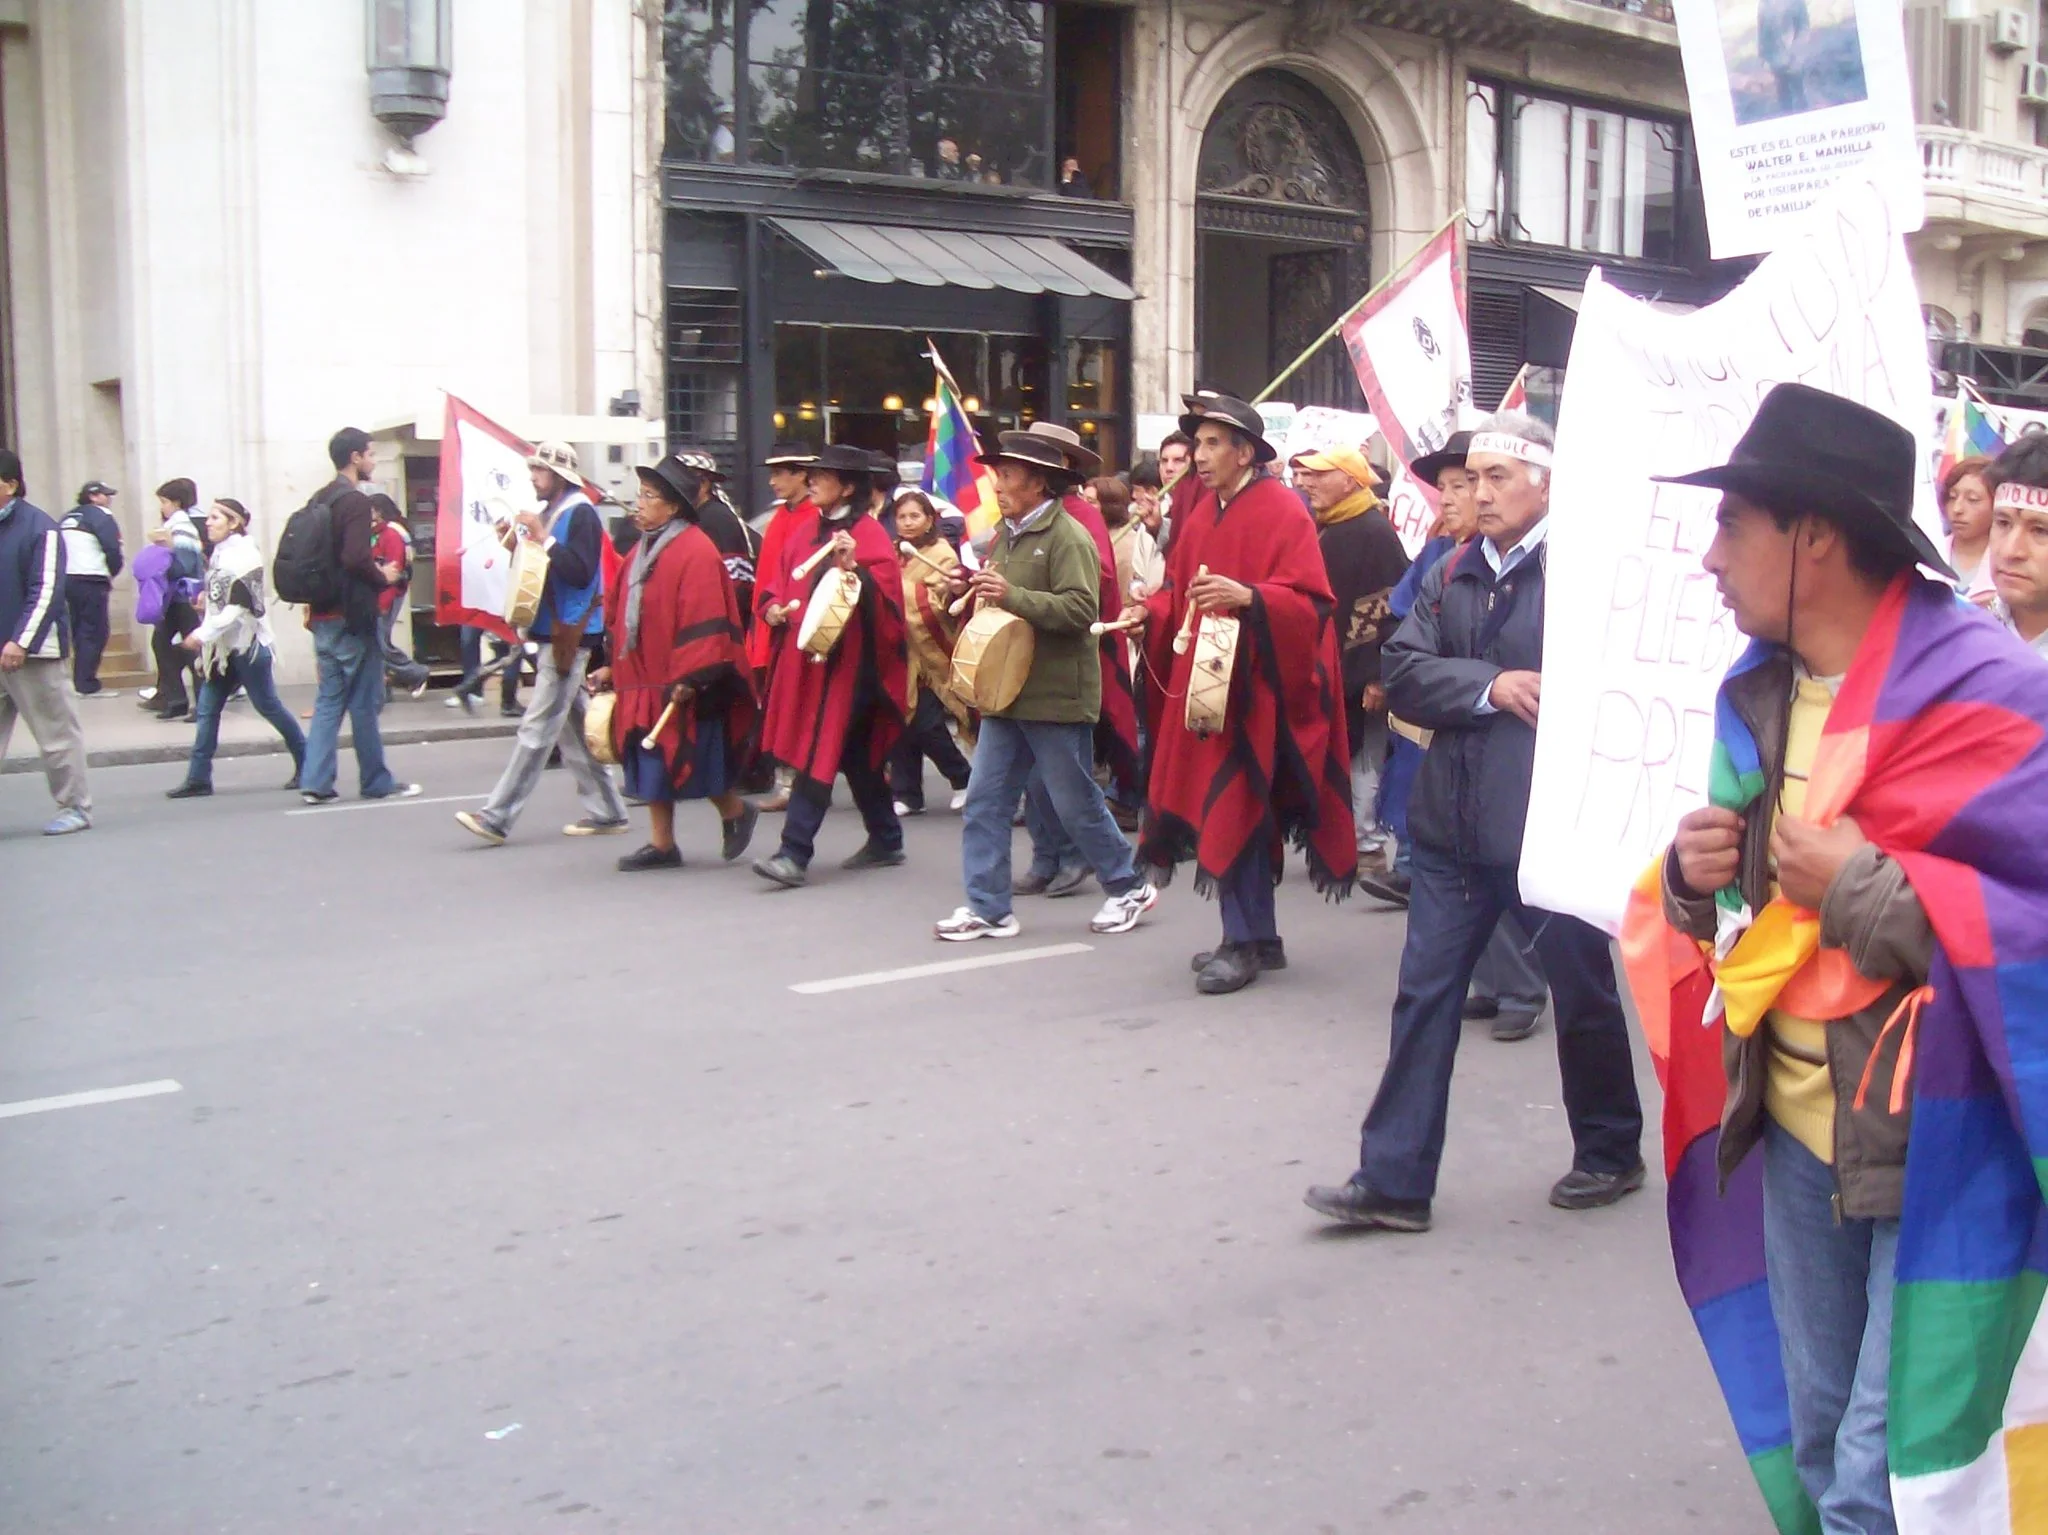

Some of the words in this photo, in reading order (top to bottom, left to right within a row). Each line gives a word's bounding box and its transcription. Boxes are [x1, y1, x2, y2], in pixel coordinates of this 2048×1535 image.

[1730, 144, 1757, 159] ESTE
[1761, 140, 1776, 152] ES
[1778, 138, 1793, 149] EL
[1795, 132, 1827, 146] CURA
[1746, 152, 1792, 171] WALTER
[1815, 140, 1872, 158] MANSILLA
[1743, 188, 1765, 200] POR
[1747, 207, 1762, 219] DE
